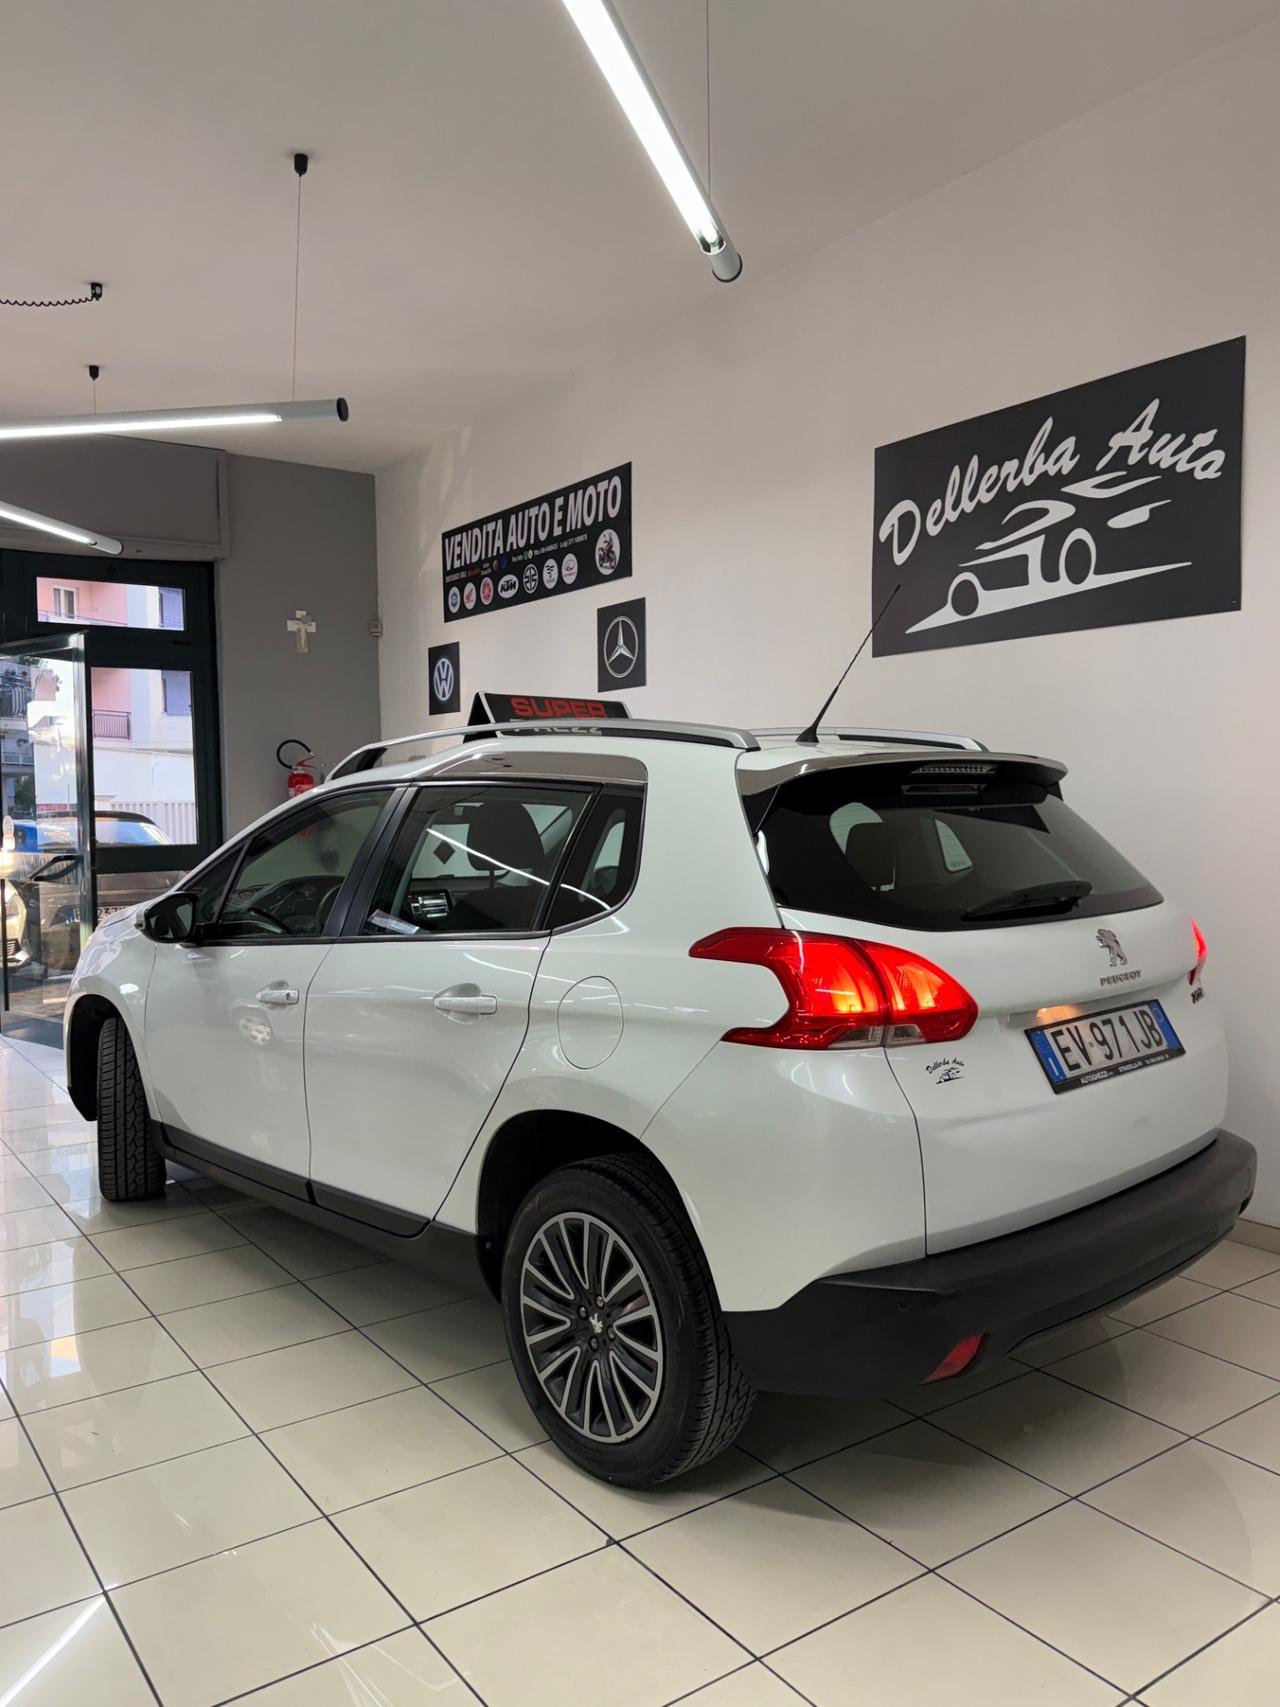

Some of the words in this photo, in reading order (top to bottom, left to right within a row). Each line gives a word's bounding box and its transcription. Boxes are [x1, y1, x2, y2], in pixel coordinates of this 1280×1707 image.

[879, 417, 1080, 566] Dellerba
[1096, 398, 1226, 481] Auto
[445, 518, 503, 571] VENDITA
[506, 502, 550, 552] AUTO
[553, 496, 564, 537] E
[566, 475, 622, 533] MOTO
[500, 579, 517, 593] KTM
[510, 697, 608, 719] SUPER
